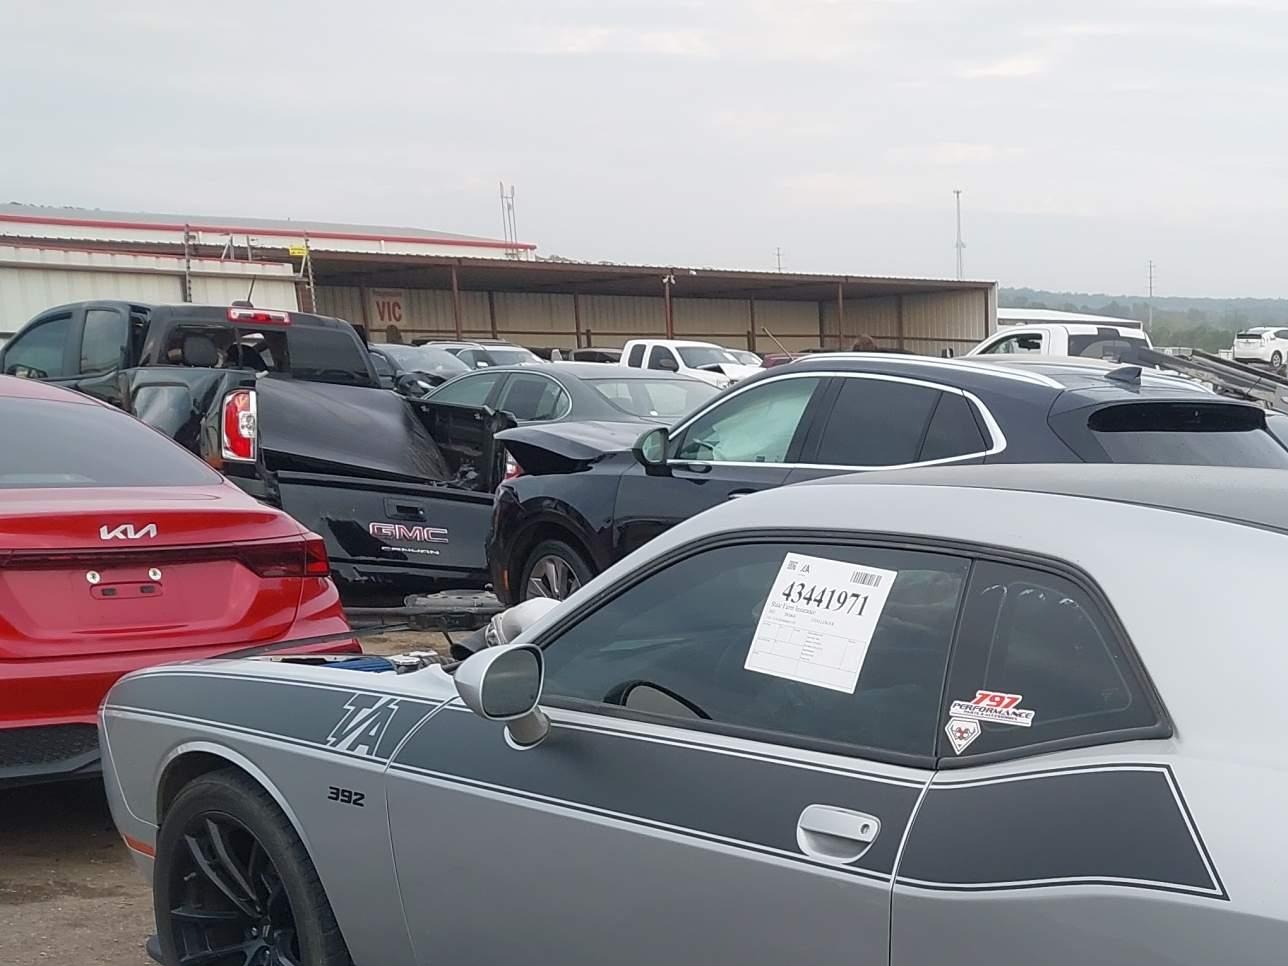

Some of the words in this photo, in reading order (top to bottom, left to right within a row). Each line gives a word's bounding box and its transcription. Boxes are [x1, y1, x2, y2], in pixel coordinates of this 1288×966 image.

[376, 301, 402, 322] VIC
[100, 523, 157, 540] KIA
[369, 522, 449, 543] GMC
[782, 581, 869, 616] 43441971
[973, 692, 1020, 709] 797
[952, 703, 1033, 720] PERFORMANCE
[327, 786, 365, 807] 392
